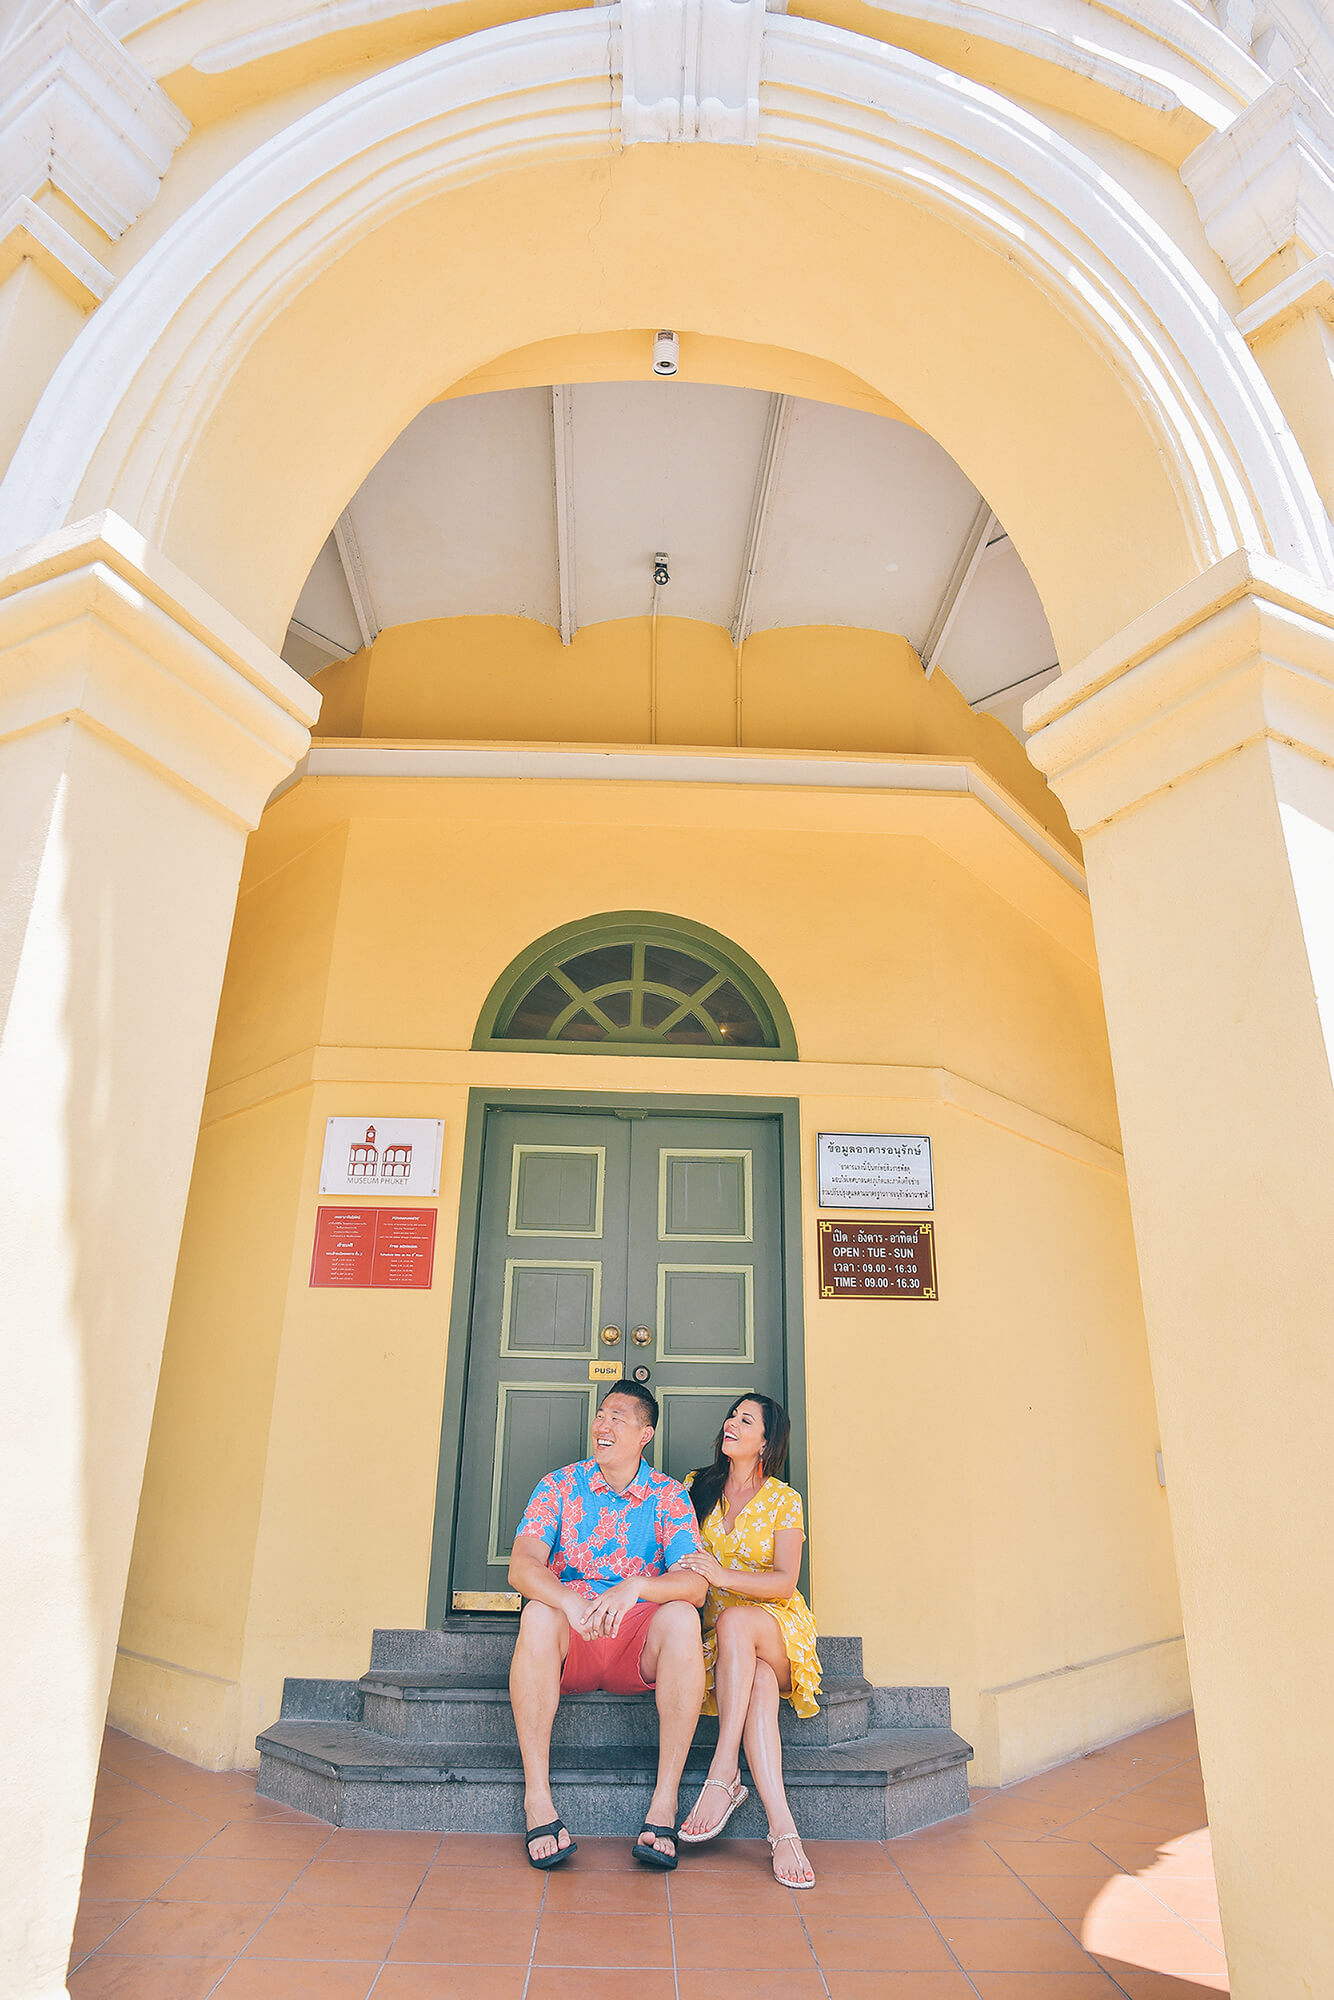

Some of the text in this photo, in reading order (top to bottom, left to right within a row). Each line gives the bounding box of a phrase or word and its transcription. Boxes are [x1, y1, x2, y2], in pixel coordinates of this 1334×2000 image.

[827, 1141, 921, 1158] ข้อมูลอาคารอนุรักษ์
[832, 1229, 848, 1242] เปิด
[857, 1230, 883, 1243] อังคาร
[889, 1229, 919, 1244] อาทิตย์
[832, 1247, 859, 1257] OPEN
[867, 1248, 886, 1258] TUE
[894, 1248, 914, 1258] SUN
[833, 1263, 854, 1272] เวลา
[862, 1264, 886, 1273] 09.00
[894, 1264, 917, 1273] 16.30
[834, 1277, 857, 1287] TIME
[864, 1277, 888, 1288] 09.00
[896, 1278, 920, 1288] 16.30
